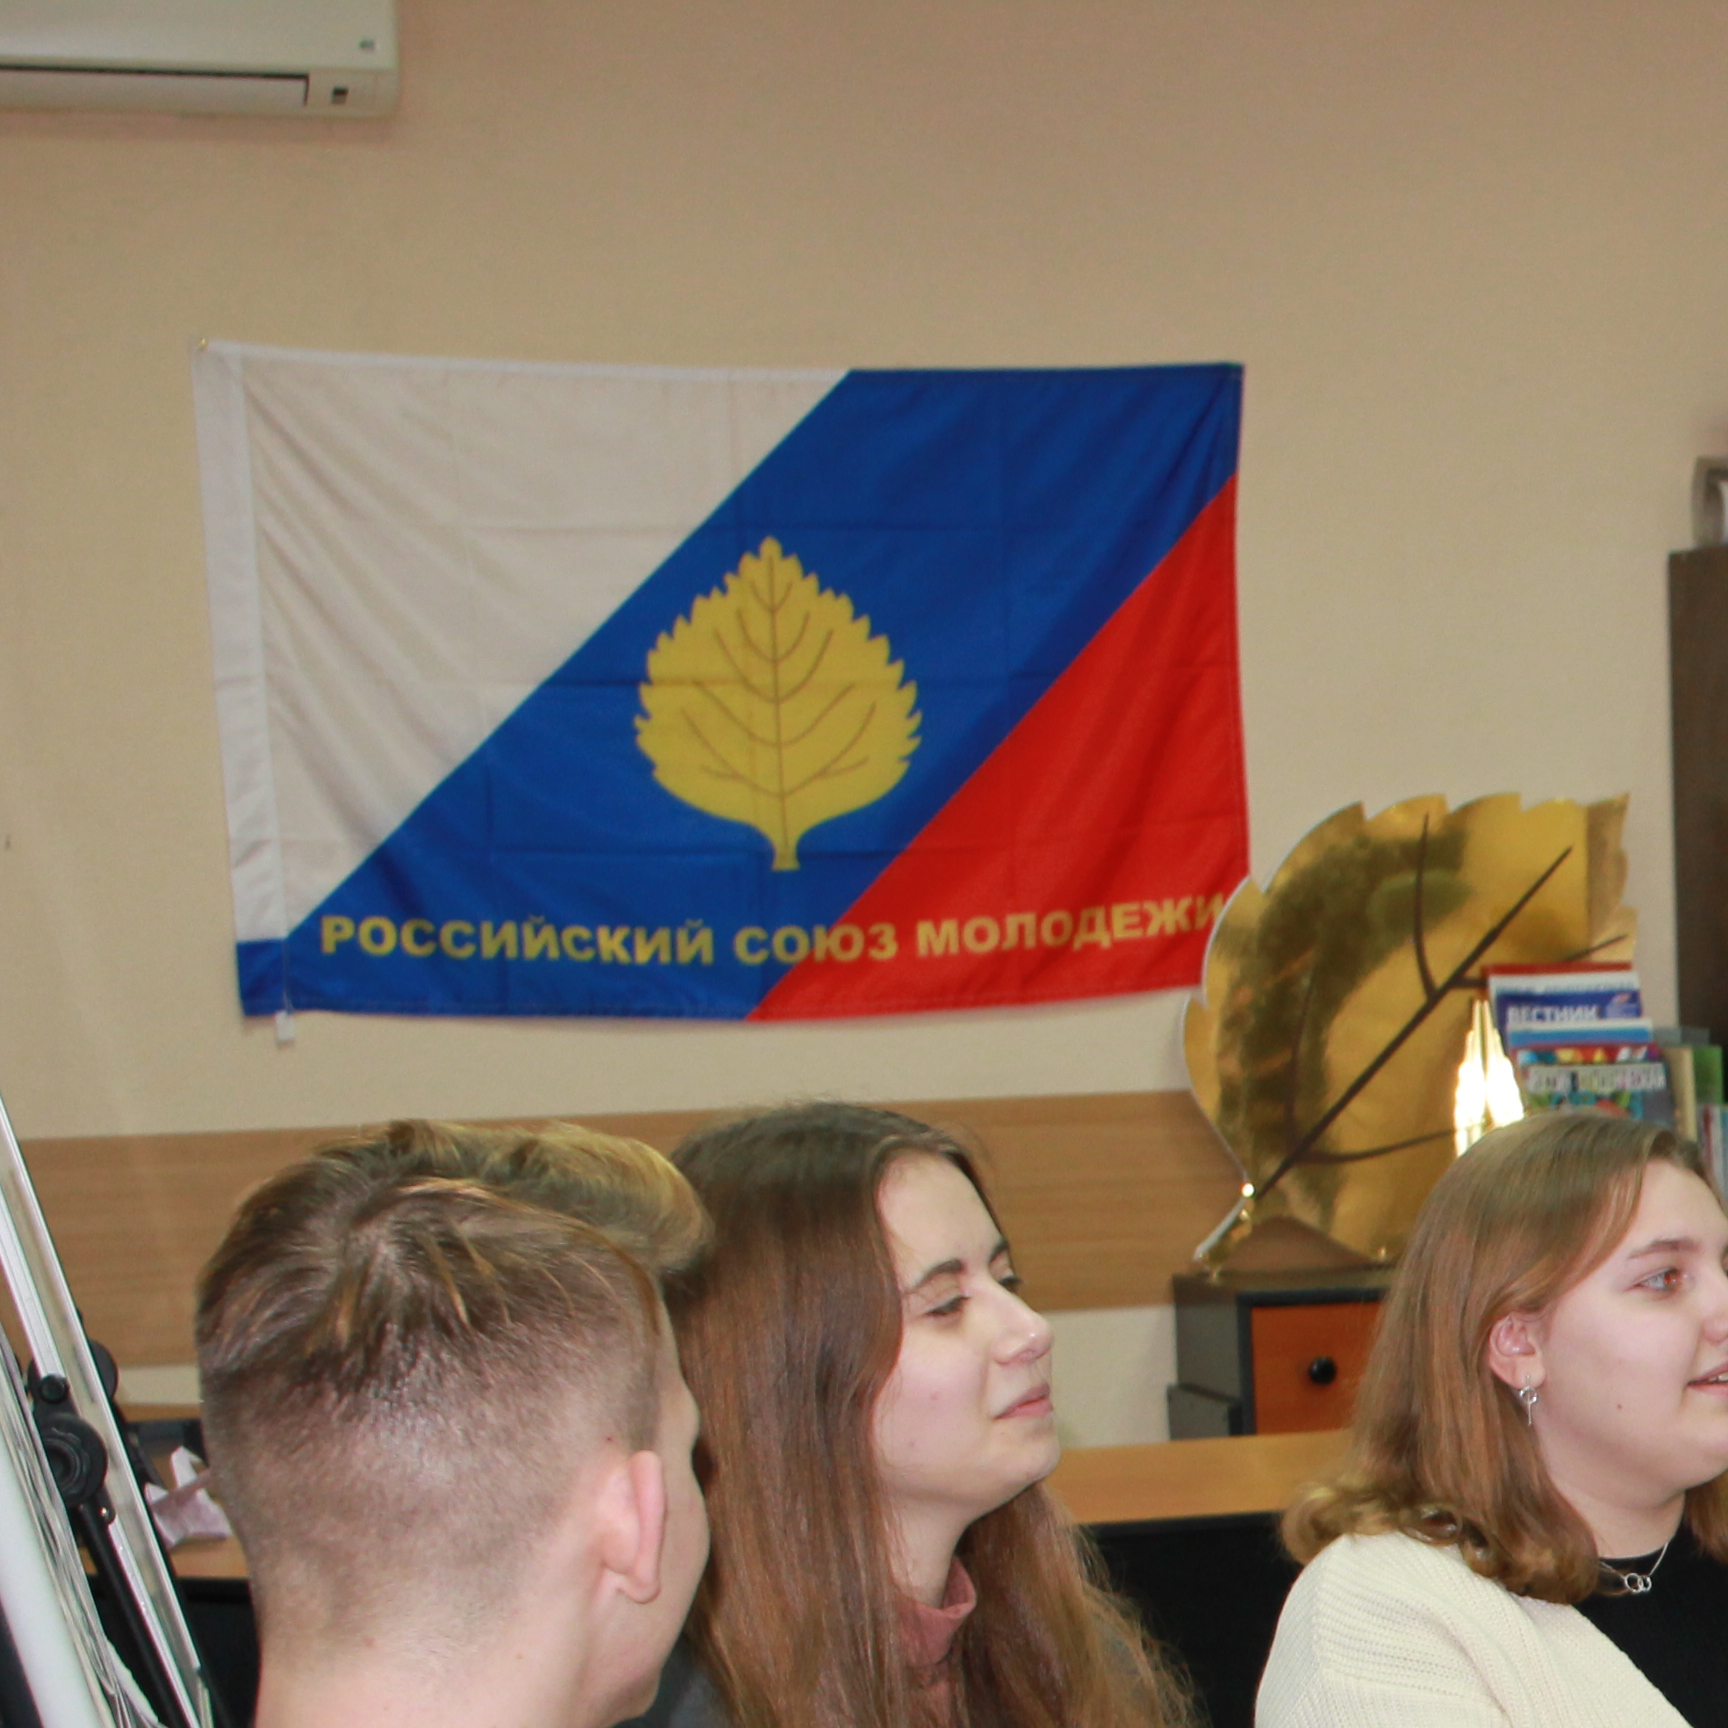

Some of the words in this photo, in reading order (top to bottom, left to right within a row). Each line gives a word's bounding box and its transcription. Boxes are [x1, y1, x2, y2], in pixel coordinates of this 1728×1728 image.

[319, 914, 714, 967] РОССИЙСКИЙ
[733, 922, 898, 965] СОЮЗ
[915, 893, 1225, 957] МОЛОДЕЖИ
